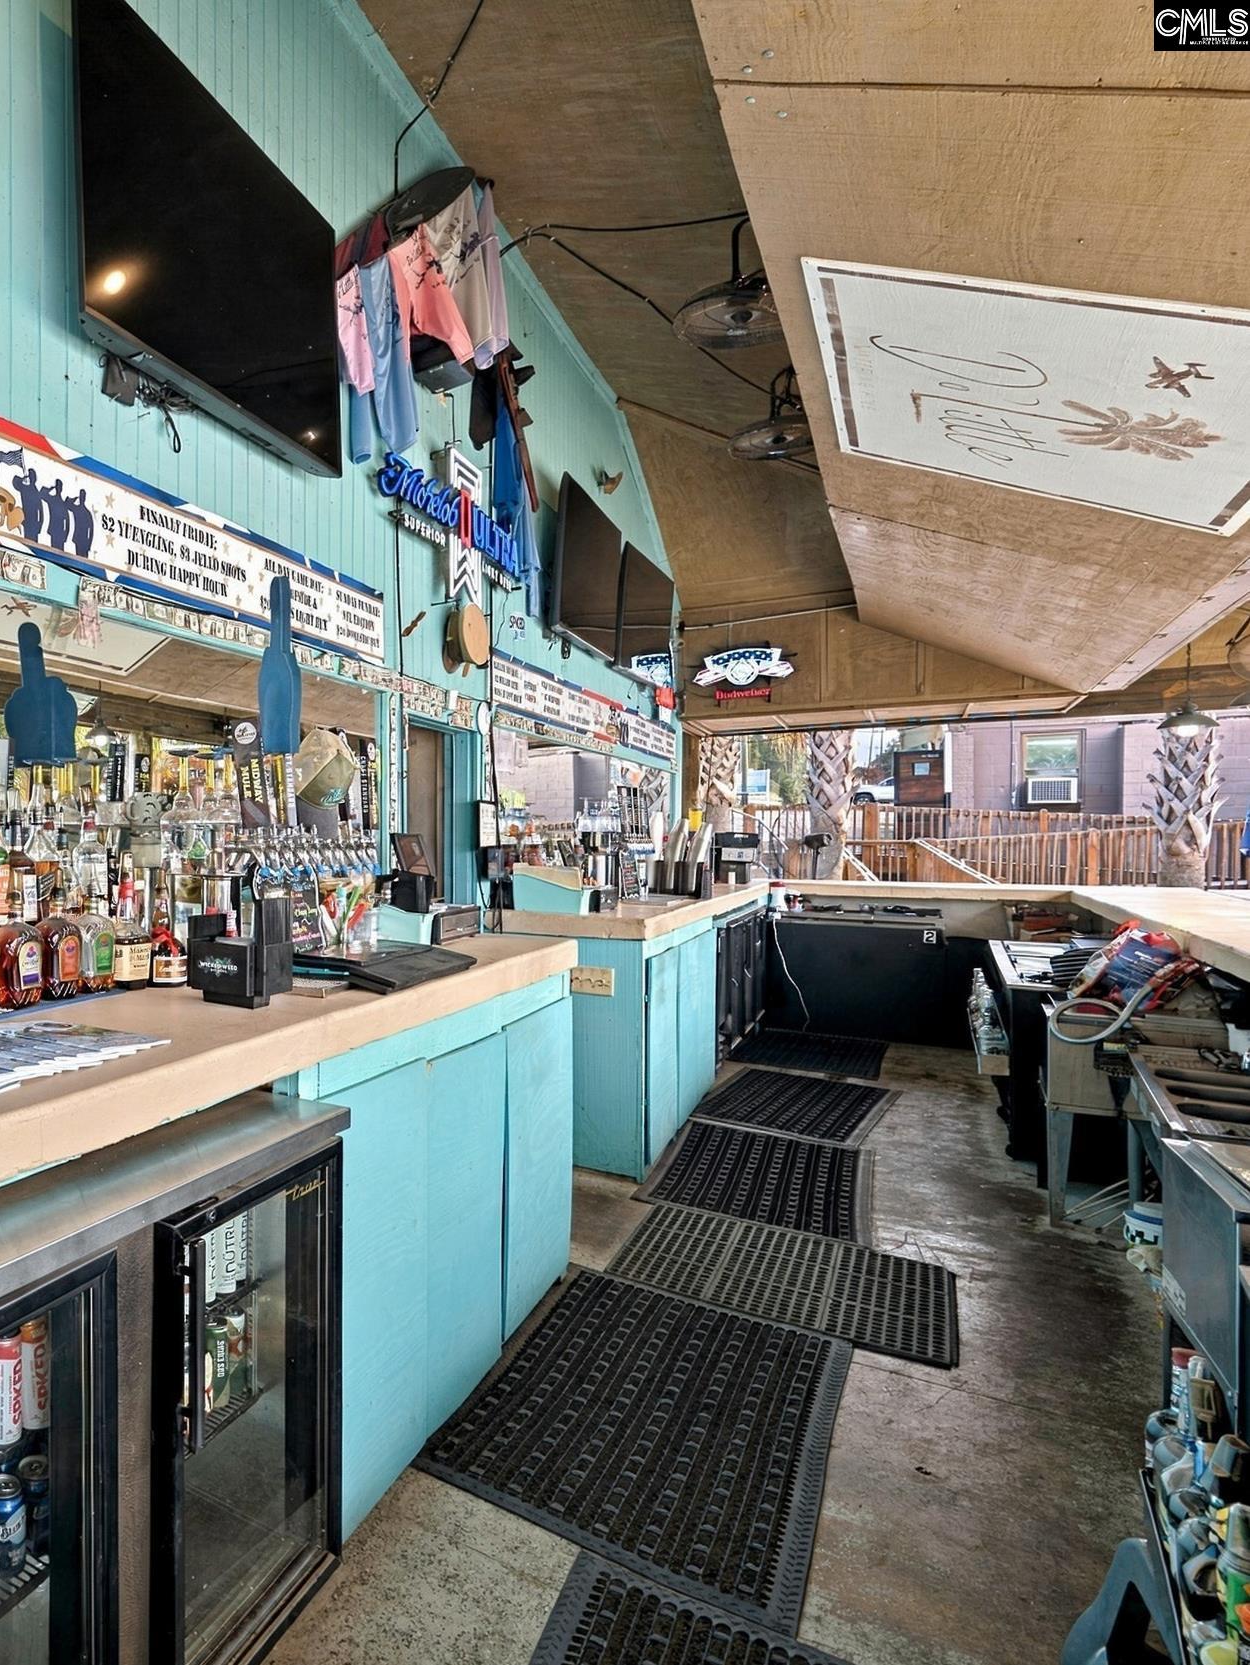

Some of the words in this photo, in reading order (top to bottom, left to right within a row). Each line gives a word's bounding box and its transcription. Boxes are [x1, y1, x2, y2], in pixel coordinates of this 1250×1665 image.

[139, 505, 181, 535] FINALLY
[182, 523, 218, 551] FRIDAY:
[404, 513, 446, 547] SUPERIOR
[472, 503, 520, 578] ULTRA
[101, 513, 115, 533] $2
[180, 545, 191, 564] $3
[192, 549, 220, 573] JELLO
[221, 561, 247, 583] SHOTS
[127, 548, 167, 577] DURING
[169, 564, 200, 588] HAPPY
[202, 576, 228, 598] HOUR
[264, 558, 276, 574] ALL
[715, 687, 772, 702] Budweiser
[240, 766, 253, 799] MULE
[251, 758, 264, 804] MIDWAY
[198, 959, 221, 969] WICKED
[286, 1179, 325, 1201] true
